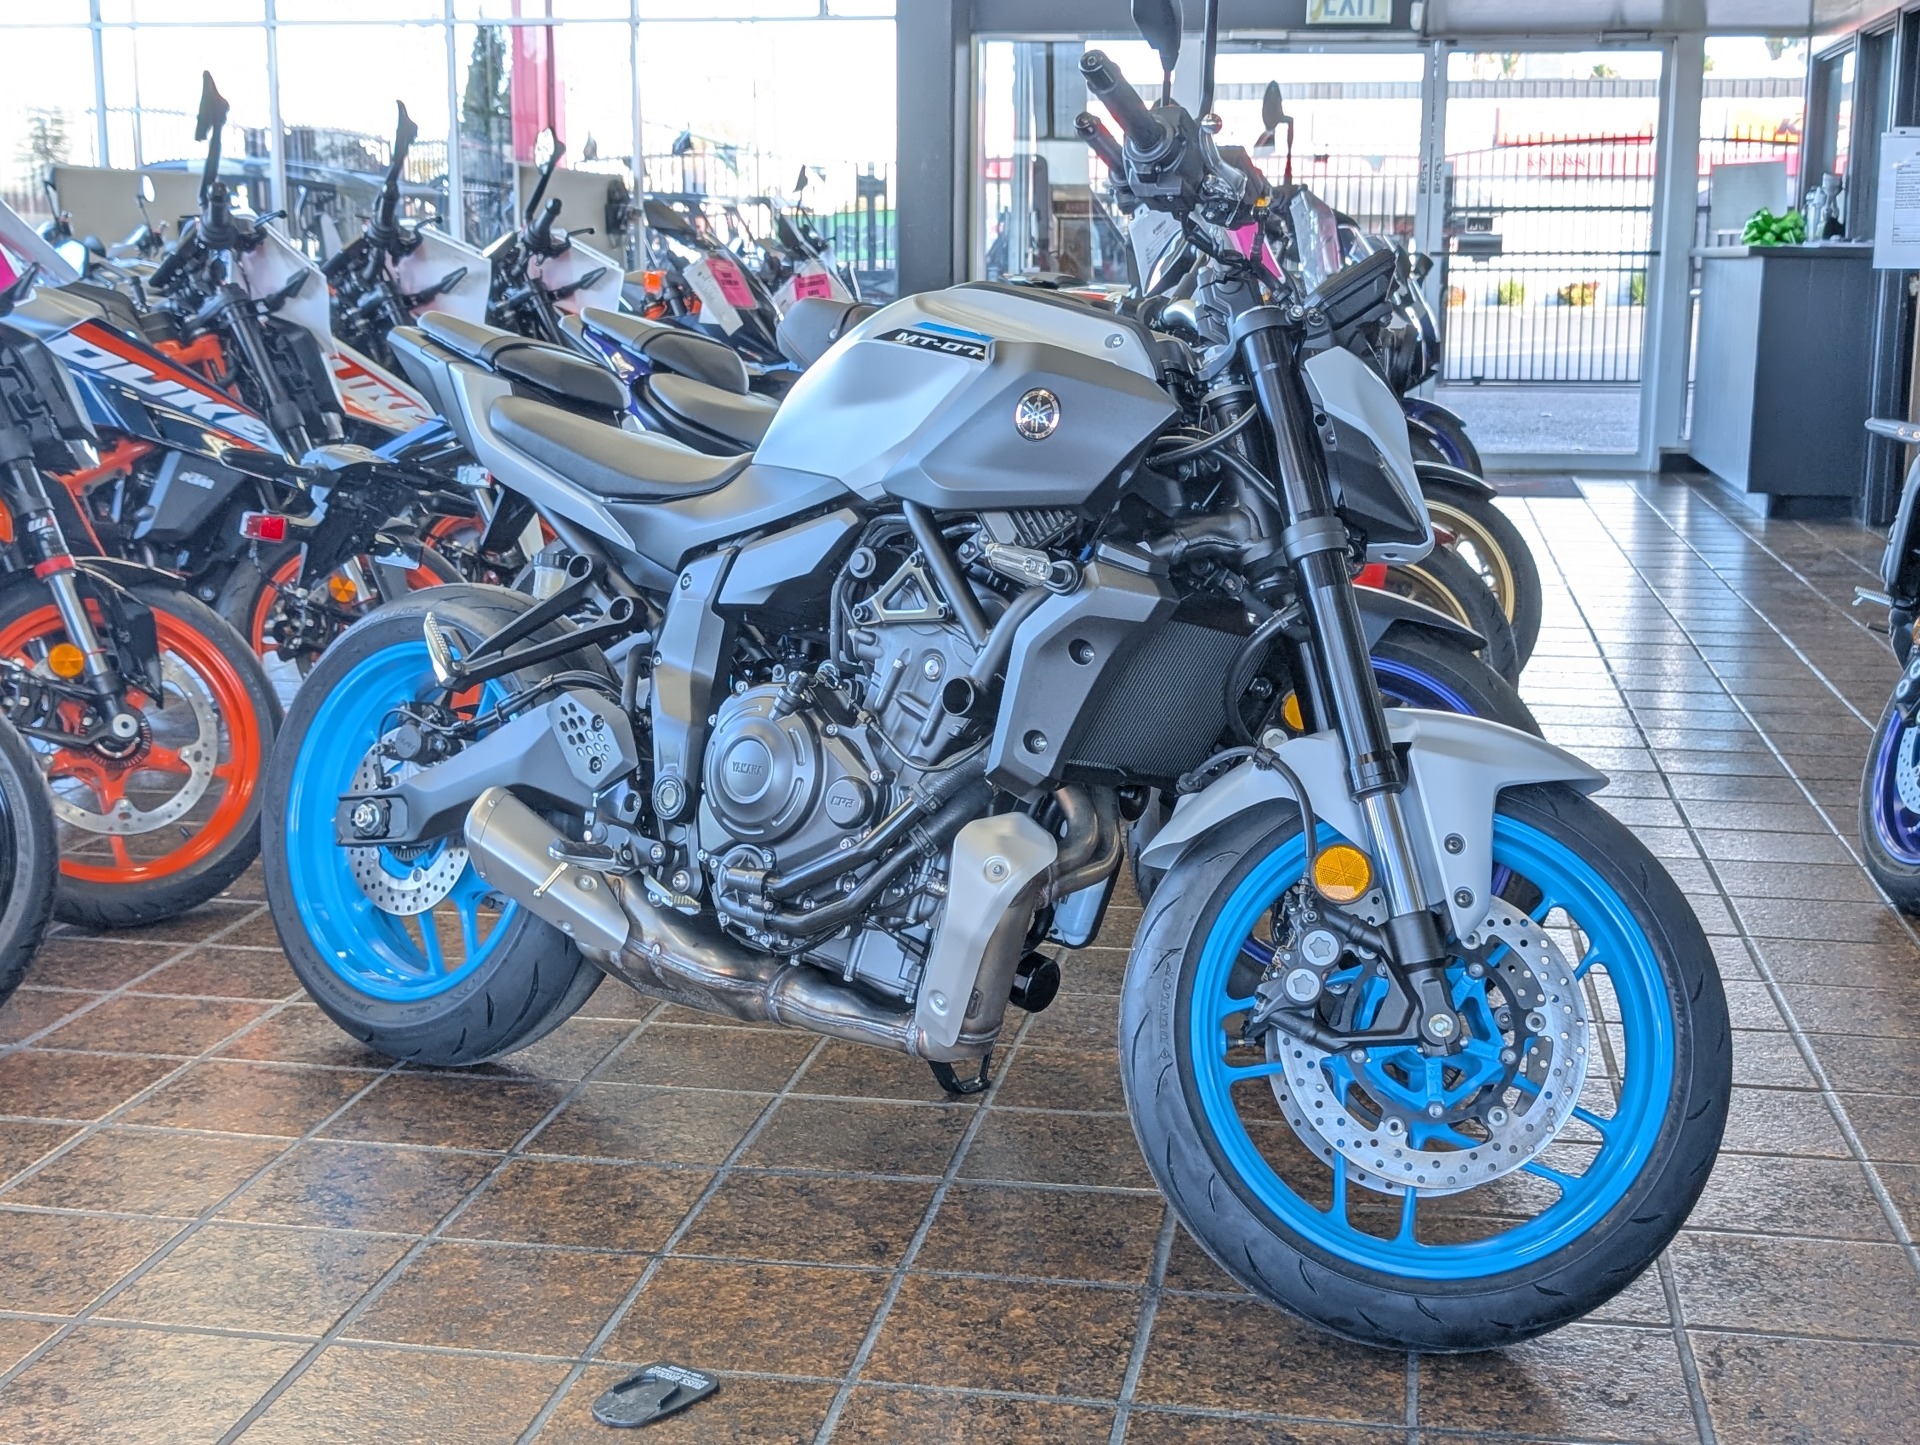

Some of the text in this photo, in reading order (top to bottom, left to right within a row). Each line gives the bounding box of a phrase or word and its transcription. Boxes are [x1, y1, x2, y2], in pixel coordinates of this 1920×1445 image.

[894, 331, 985, 356] MT-07
[47, 332, 279, 453] DUKE
[732, 760, 763, 776] YAMAHA
[1159, 961, 1174, 1044] DUNLOP
